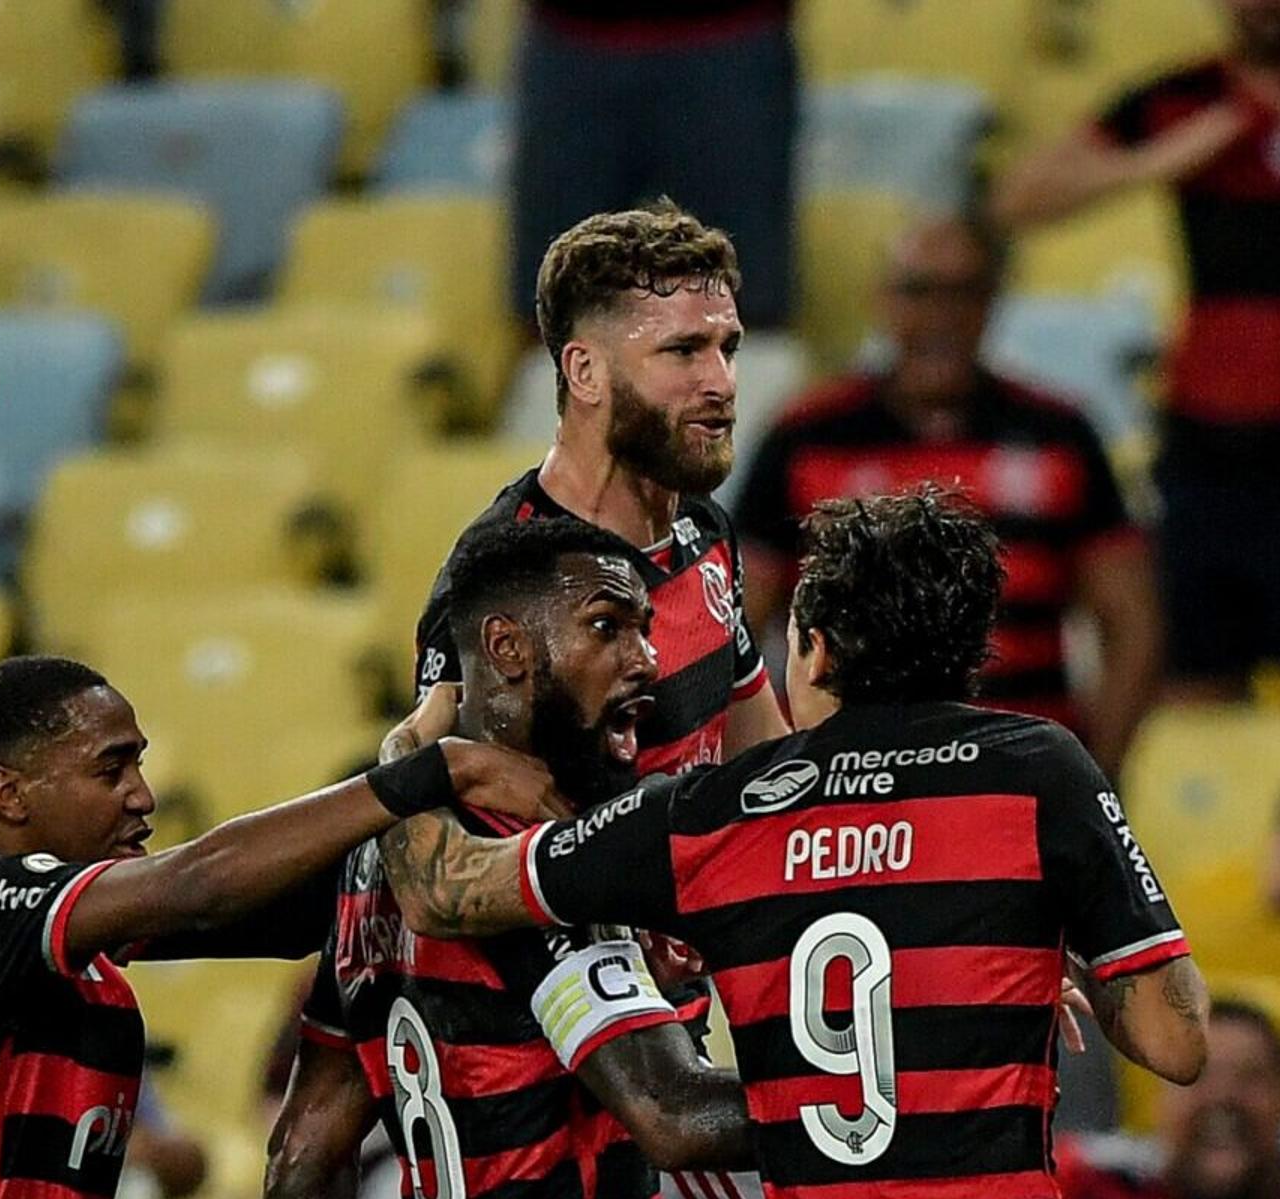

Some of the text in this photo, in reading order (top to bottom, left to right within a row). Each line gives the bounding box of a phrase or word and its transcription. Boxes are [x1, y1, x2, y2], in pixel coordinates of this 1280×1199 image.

[828, 740, 980, 772] mercado
[824, 771, 895, 798] livre
[576, 788, 646, 844] kwai
[784, 819, 914, 882] PEDRO
[1117, 825, 1165, 903] kwai
[587, 954, 640, 1002] C
[789, 910, 897, 1166] 9
